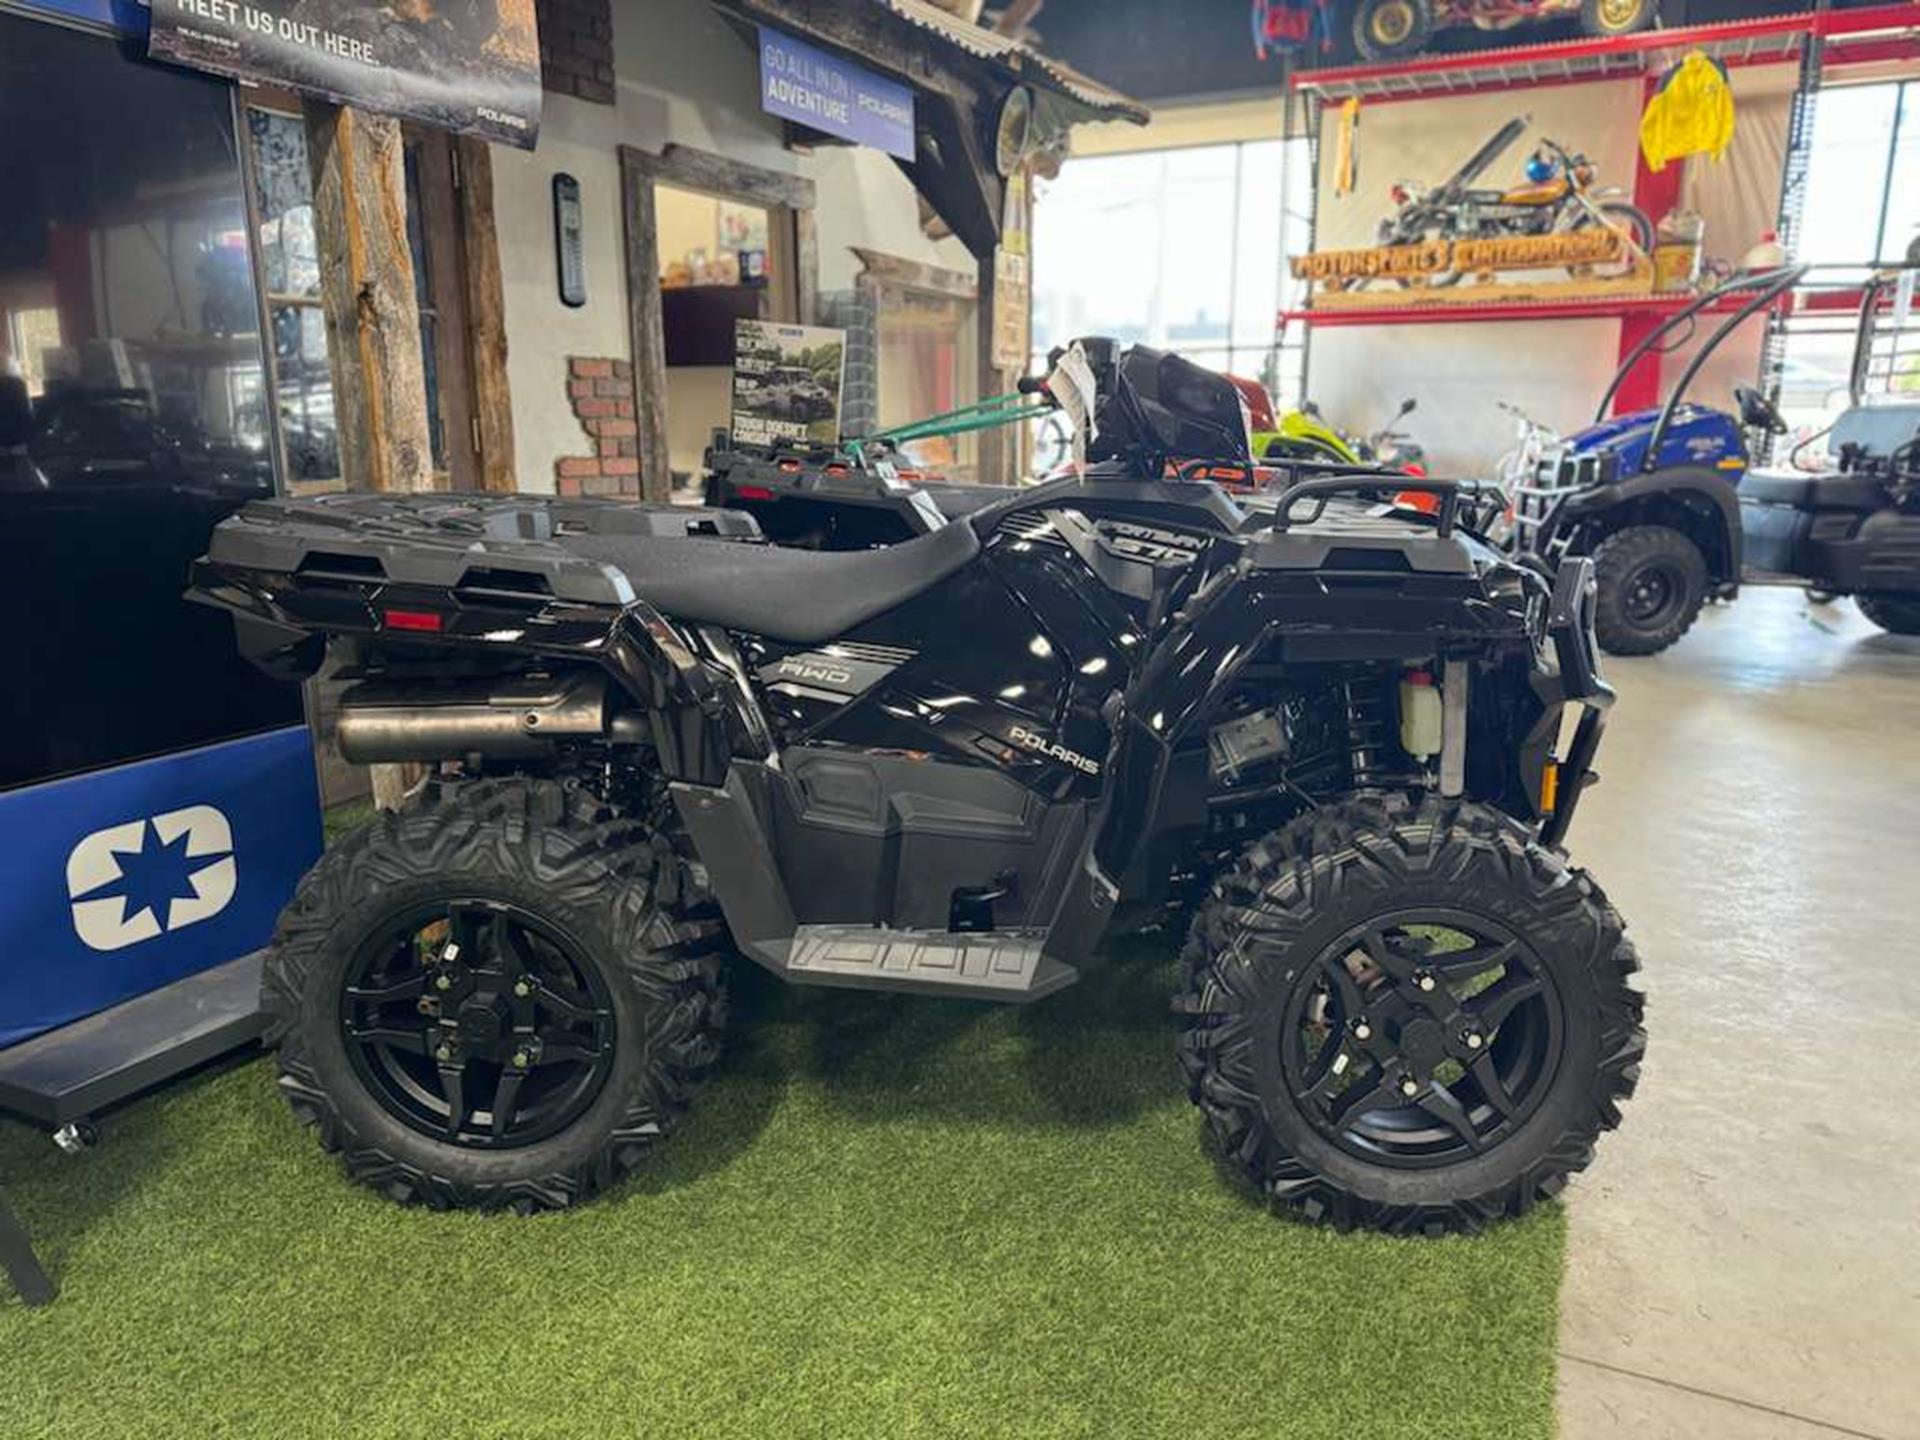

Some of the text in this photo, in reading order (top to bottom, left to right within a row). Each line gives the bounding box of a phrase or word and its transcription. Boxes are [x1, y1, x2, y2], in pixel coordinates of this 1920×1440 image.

[177, 0, 381, 66] MEET US OUT HERE.
[765, 44, 785, 72] GO
[787, 54, 814, 85] ALL
[768, 75, 849, 124] ADVENTURE
[779, 663, 850, 683] AWD
[1009, 726, 1099, 775] POLARIS
